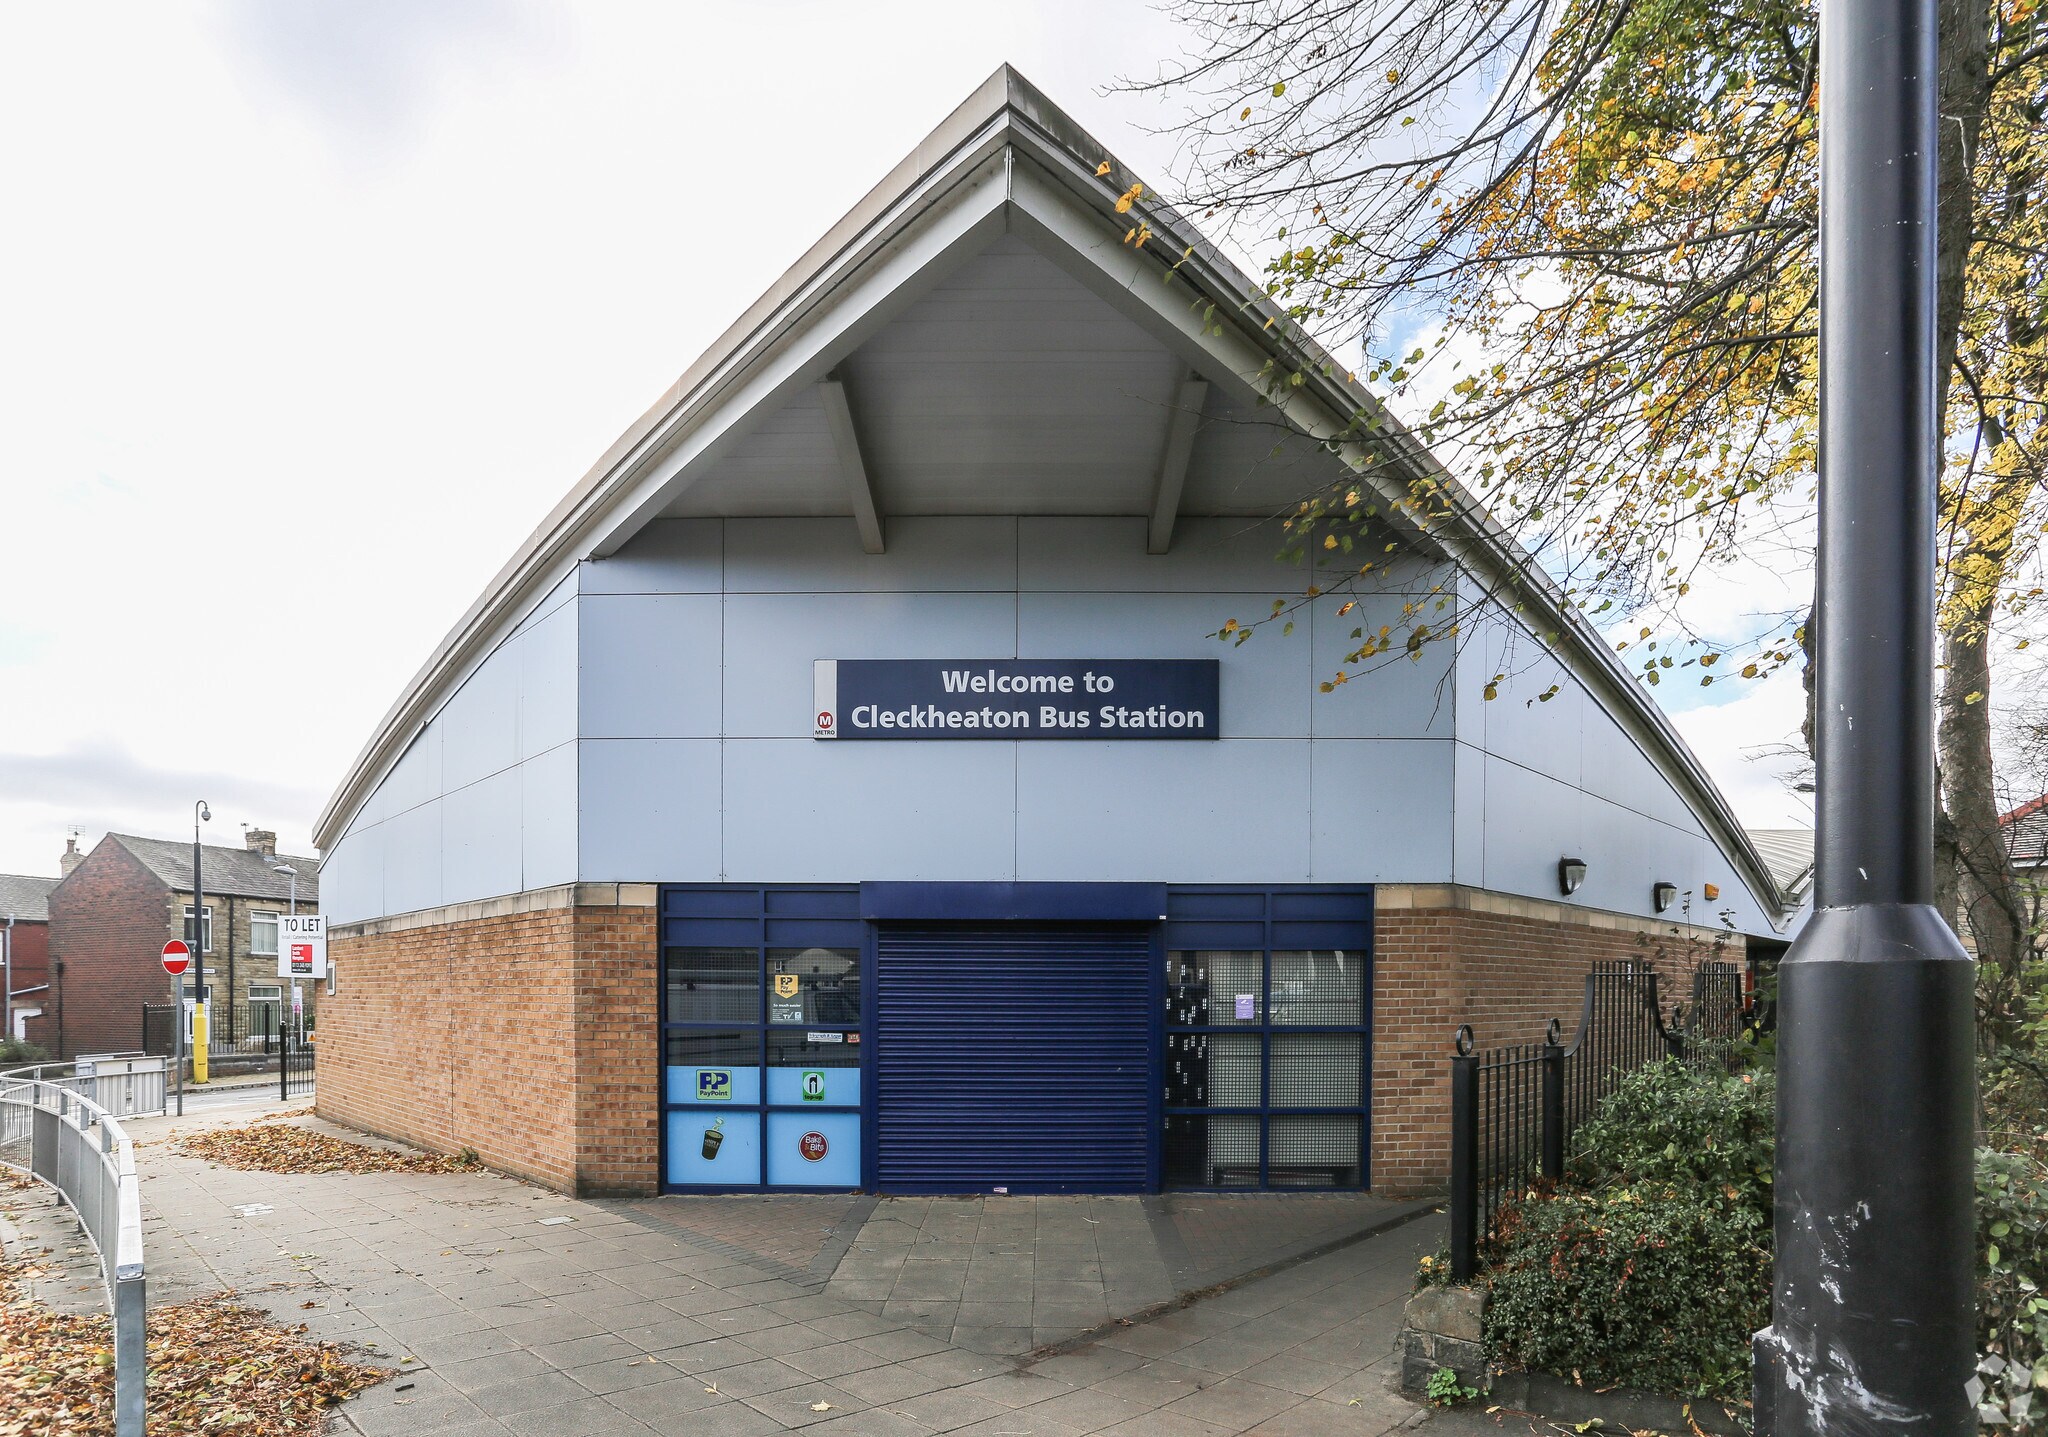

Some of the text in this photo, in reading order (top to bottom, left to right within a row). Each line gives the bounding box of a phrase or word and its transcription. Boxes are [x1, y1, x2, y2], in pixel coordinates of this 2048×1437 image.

[942, 669, 1114, 693] Welcome to
[819, 715, 832, 726] M
[851, 704, 1204, 729] Cleckheaton Bus Station
[284, 918, 321, 931] TO LET
[805, 1135, 822, 1143] Bake
[810, 1143, 824, 1151] Bite
